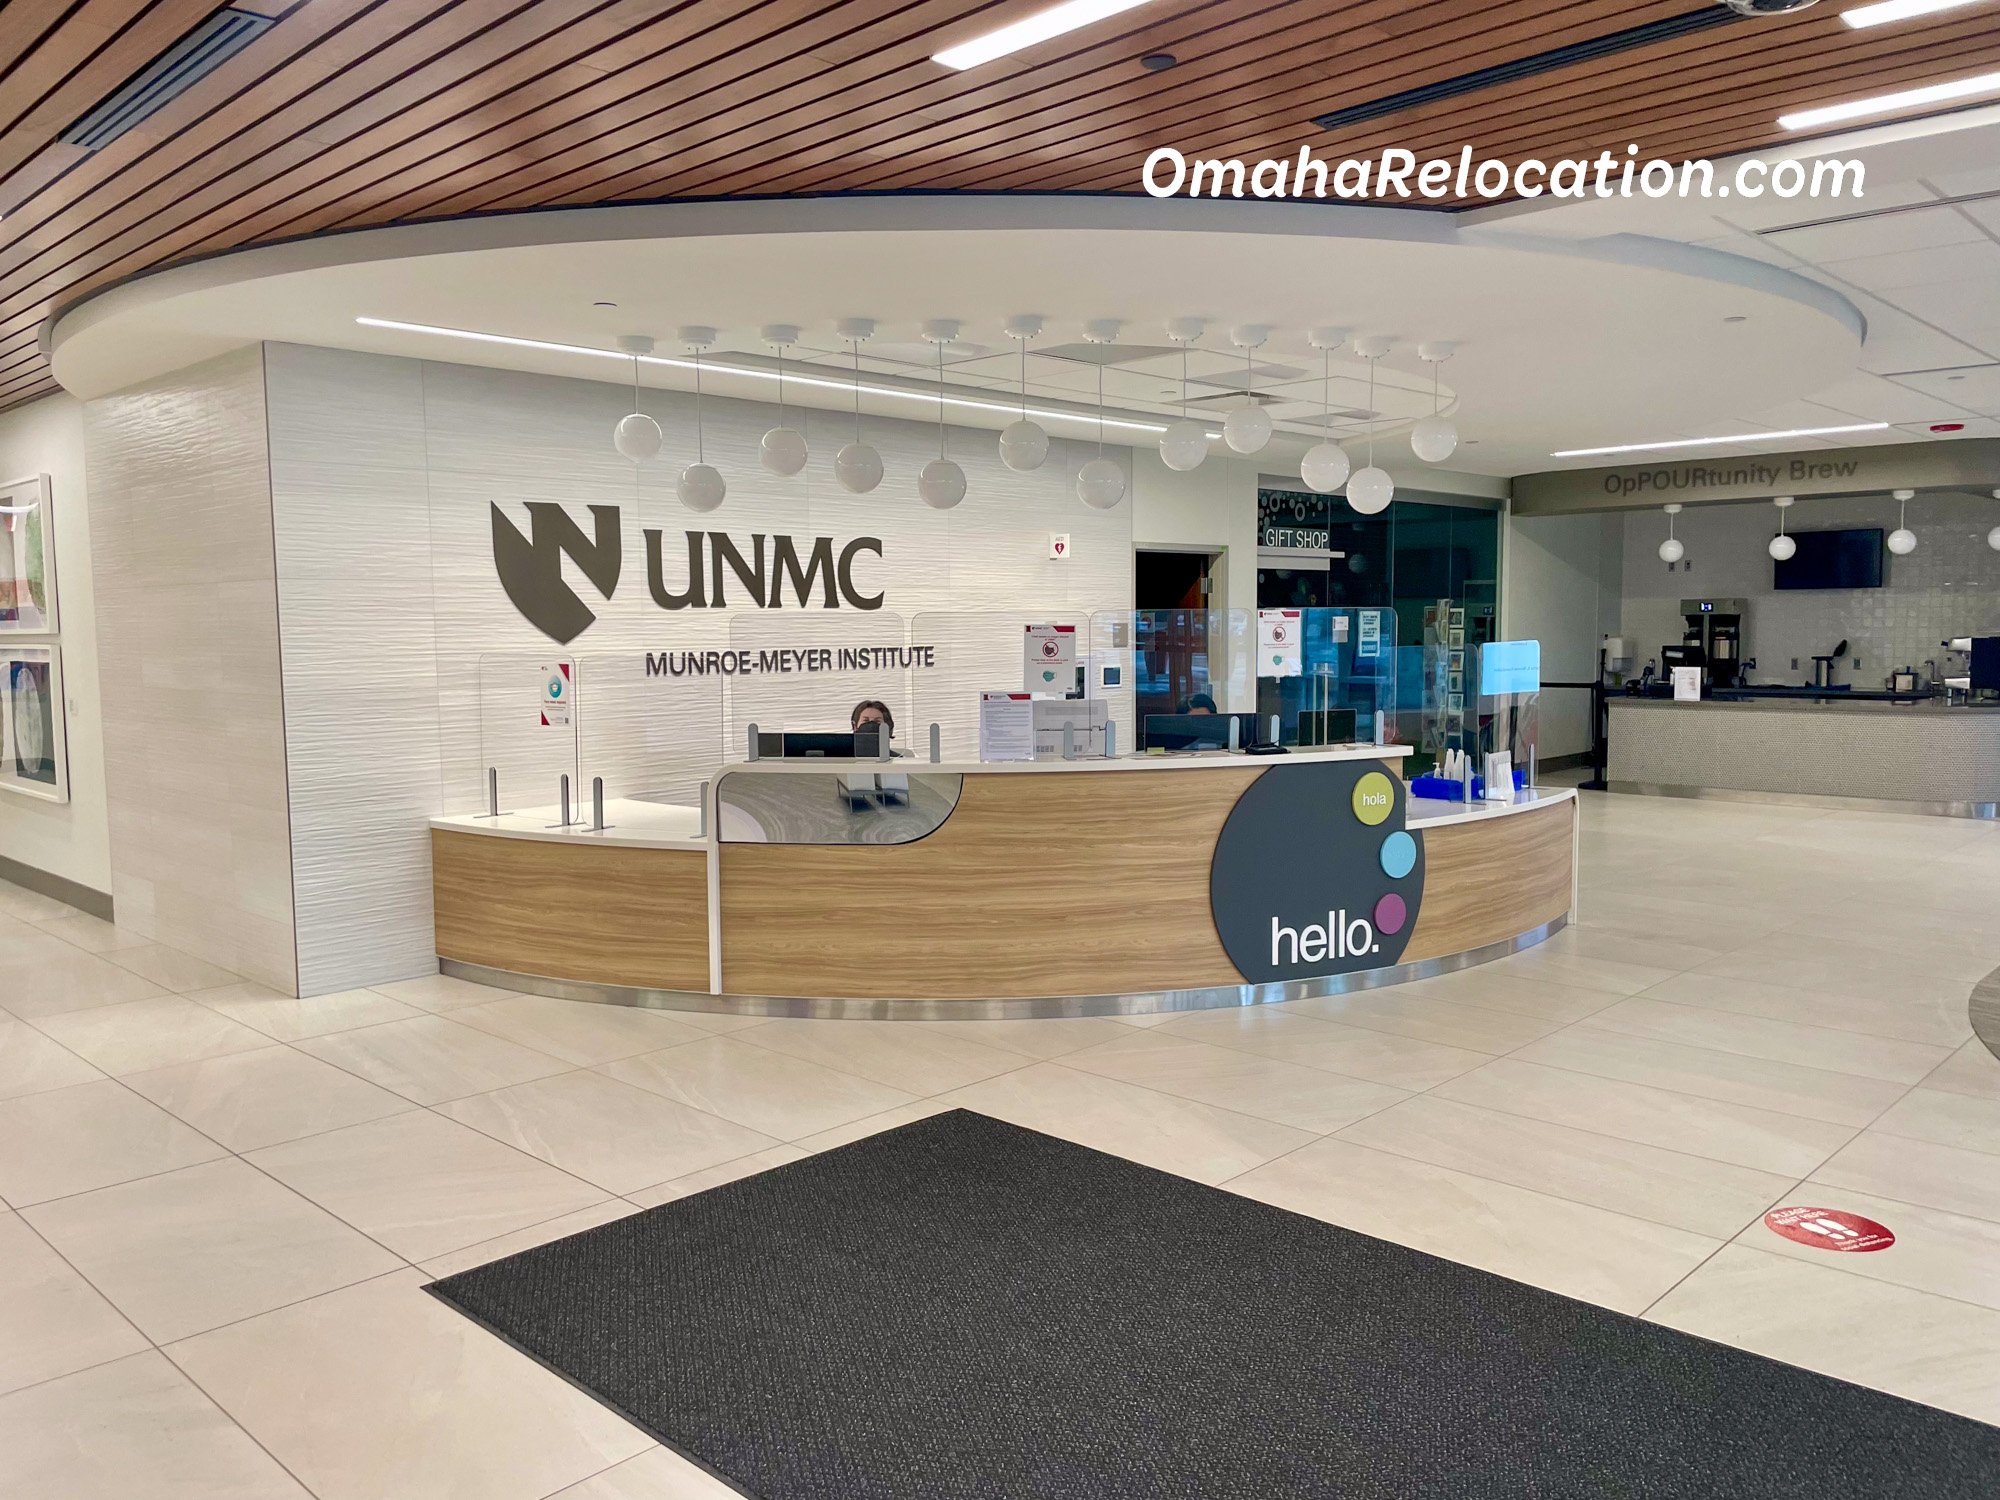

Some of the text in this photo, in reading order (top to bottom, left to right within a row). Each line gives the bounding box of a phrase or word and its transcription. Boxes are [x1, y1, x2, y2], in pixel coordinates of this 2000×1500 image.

[1604, 460, 1859, 497] OpPOURtunity Brew
[1265, 528, 1329, 549] GIFT SHOP
[643, 529, 885, 610] UNMC
[645, 646, 935, 677] MUNROE-MEYER INSTITUTE
[1362, 792, 1387, 806] hola
[1271, 909, 1380, 966] hello.
